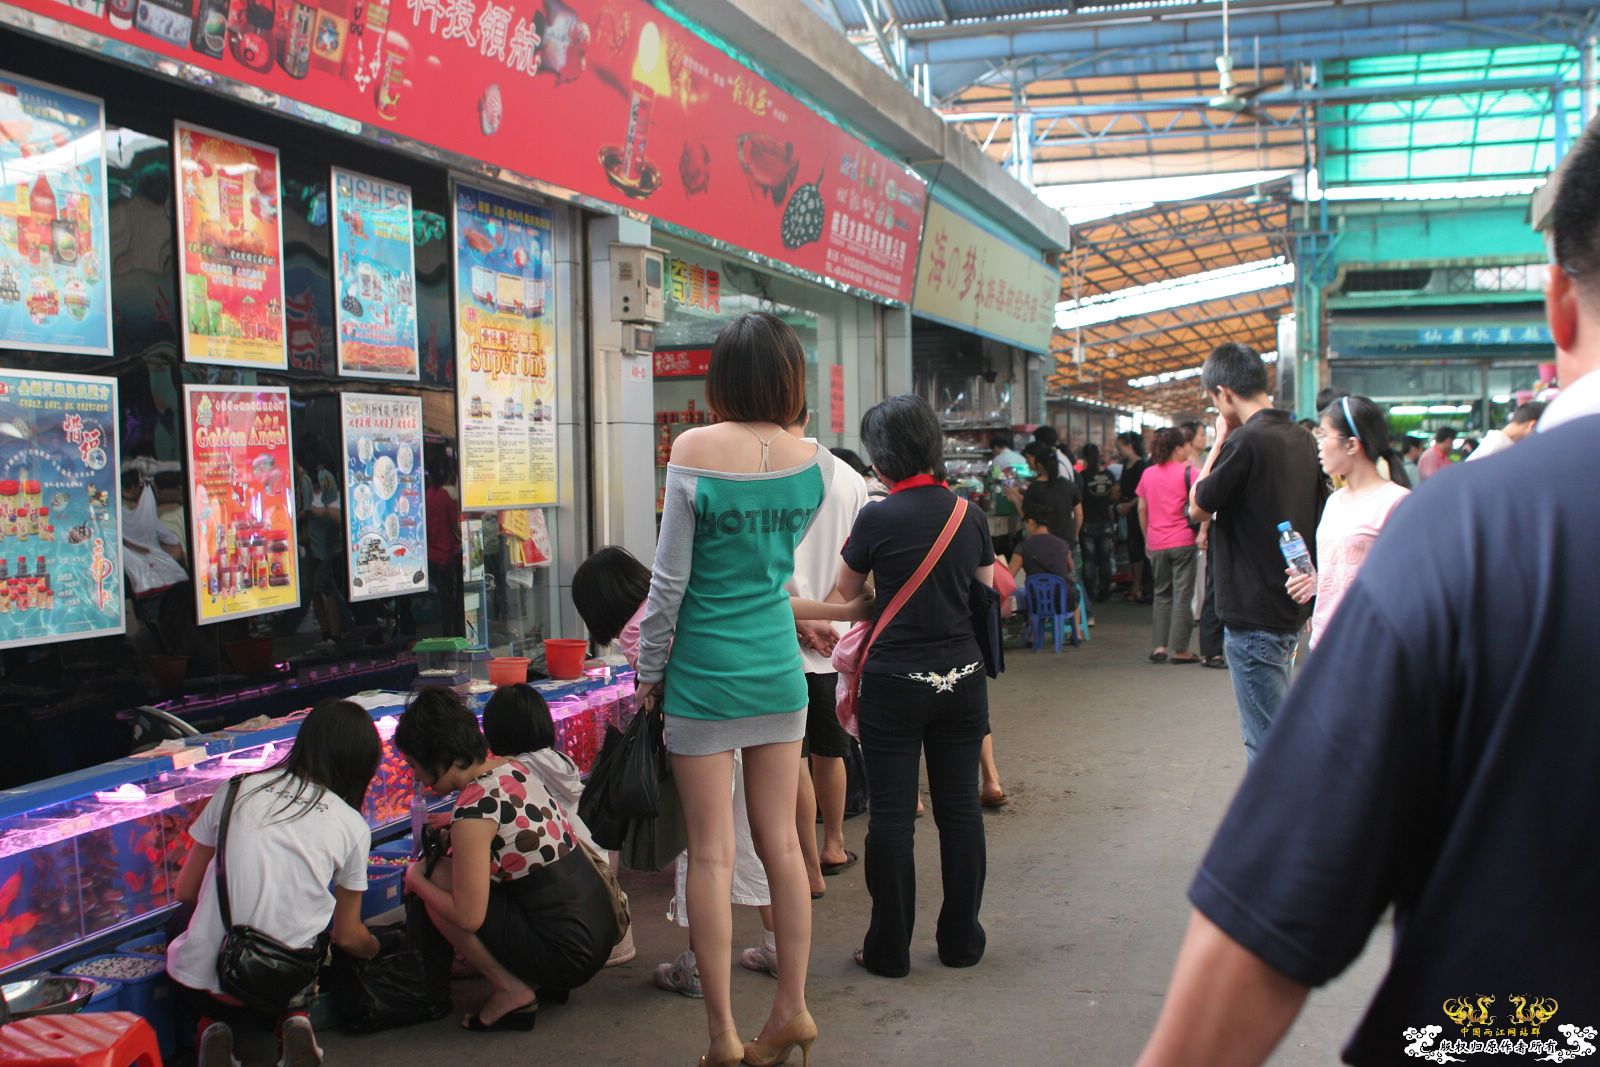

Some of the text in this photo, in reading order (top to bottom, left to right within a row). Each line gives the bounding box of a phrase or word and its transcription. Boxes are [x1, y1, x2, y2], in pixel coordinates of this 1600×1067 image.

[470, 341, 519, 381] Super
[521, 354, 547, 378] one
[195, 425, 287, 450] Golden Angel
